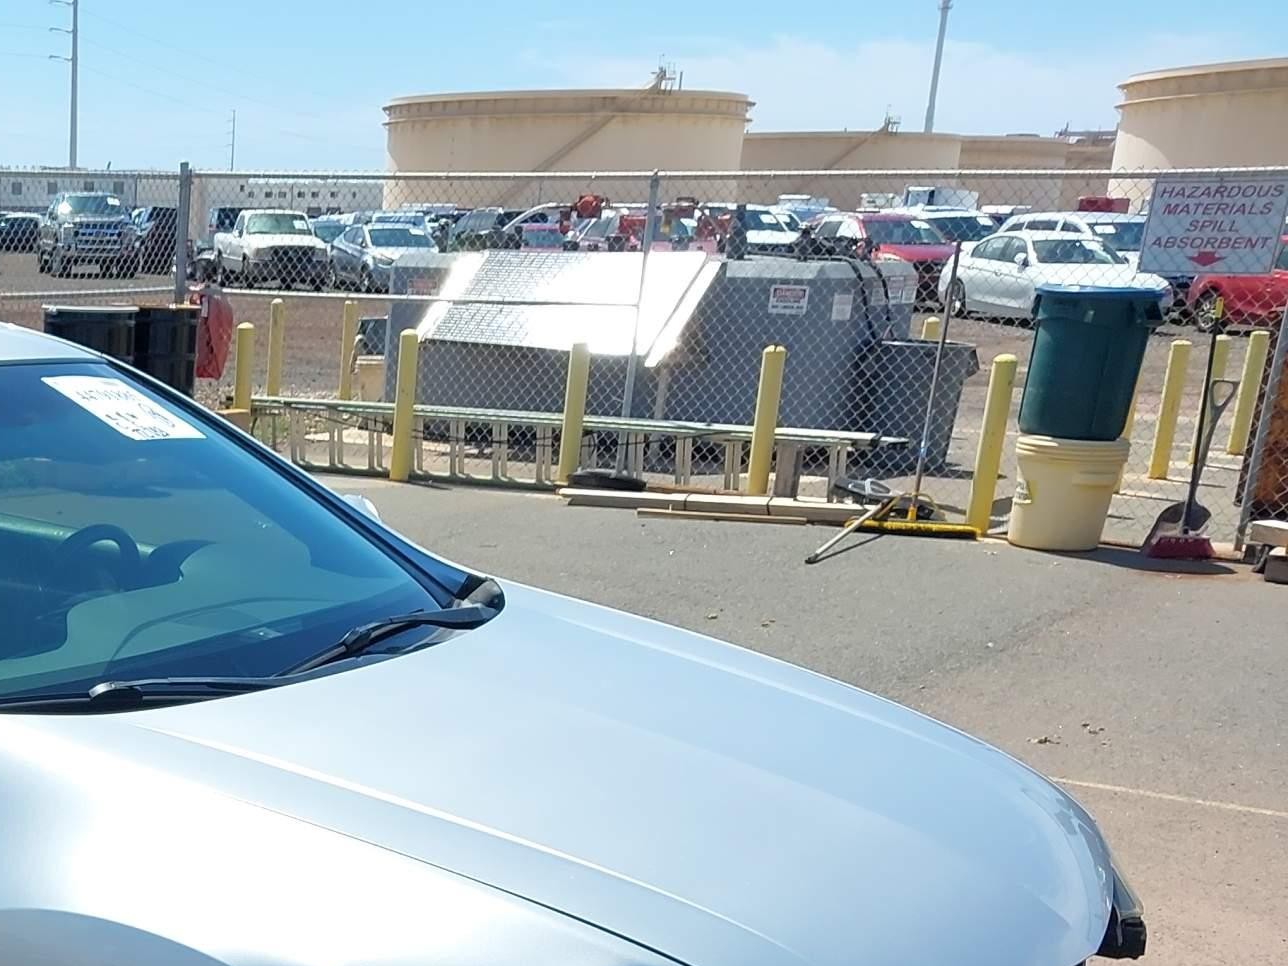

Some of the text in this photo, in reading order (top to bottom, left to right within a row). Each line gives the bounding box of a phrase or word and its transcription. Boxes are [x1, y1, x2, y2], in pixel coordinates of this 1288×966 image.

[1160, 184, 1285, 199] HAZARDOUS
[1162, 202, 1274, 216] MATERIALS
[1186, 219, 1240, 233] SPILL
[1151, 236, 1272, 249] ABSORBENT
